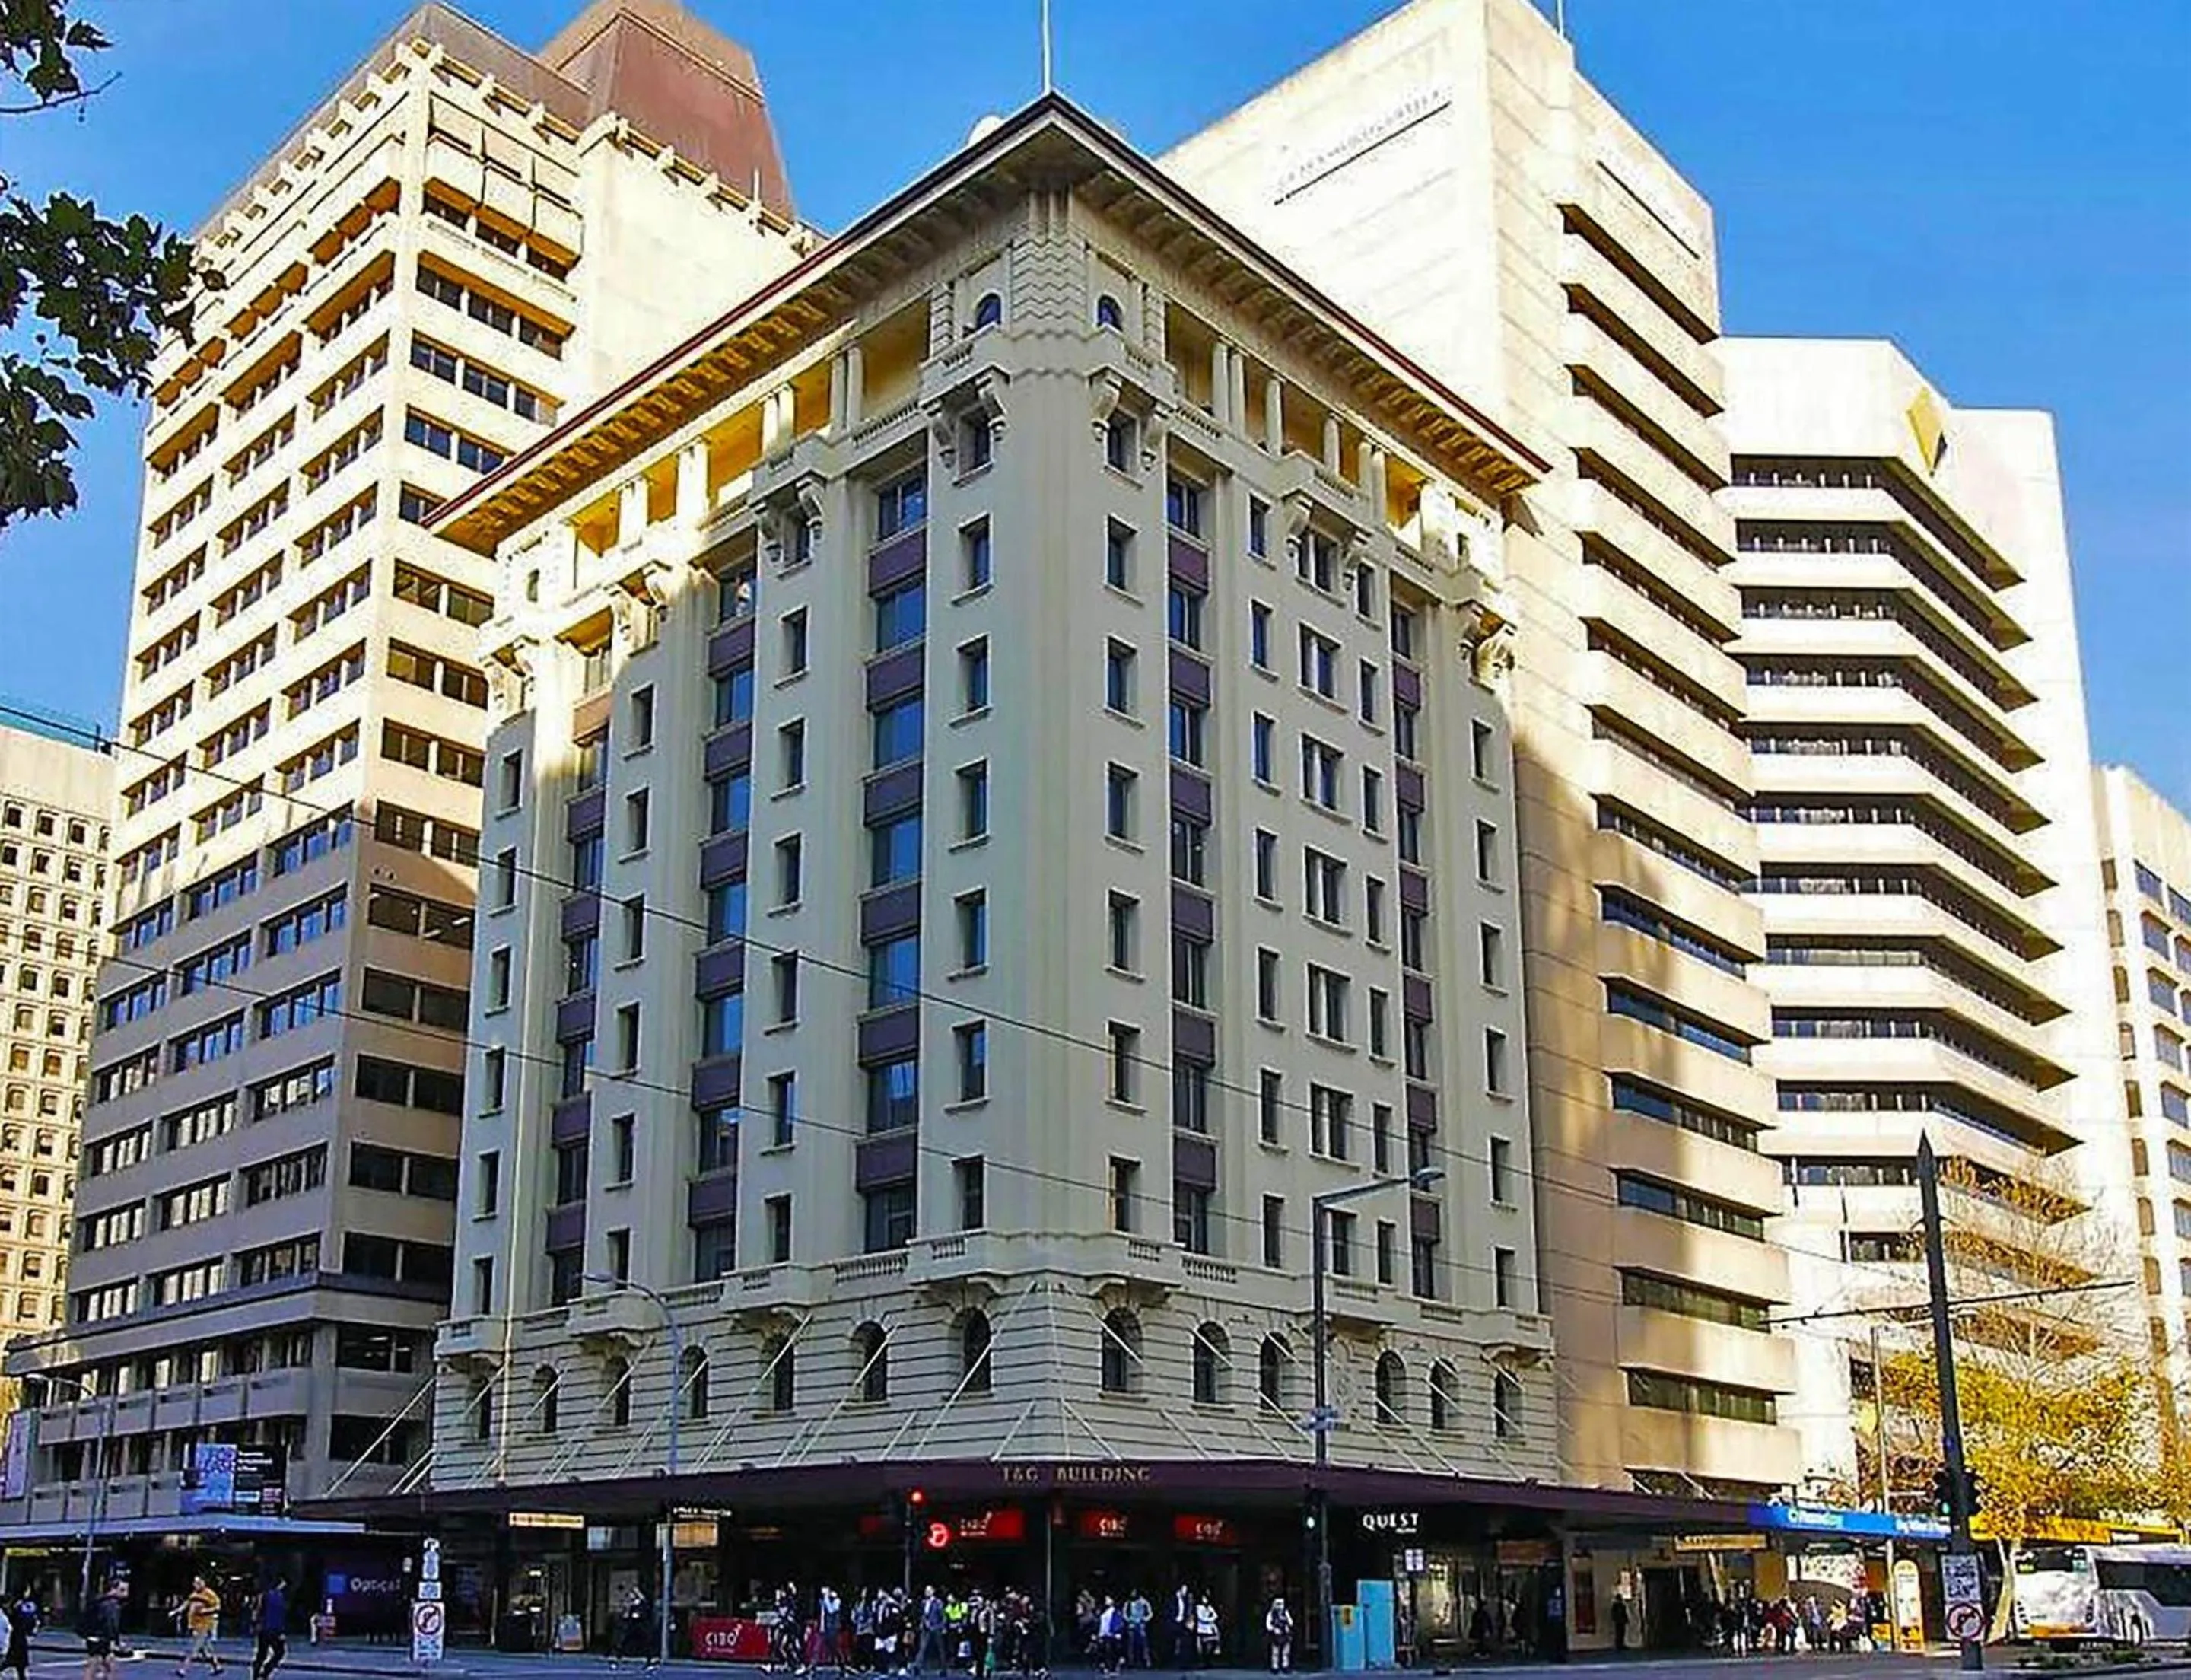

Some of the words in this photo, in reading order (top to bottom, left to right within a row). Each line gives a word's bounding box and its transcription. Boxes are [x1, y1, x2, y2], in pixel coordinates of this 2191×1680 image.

[1003, 1466, 1039, 1481] T&G
[1056, 1465, 1151, 1481] BUILDING
[1362, 1513, 1419, 1532] QUEST
